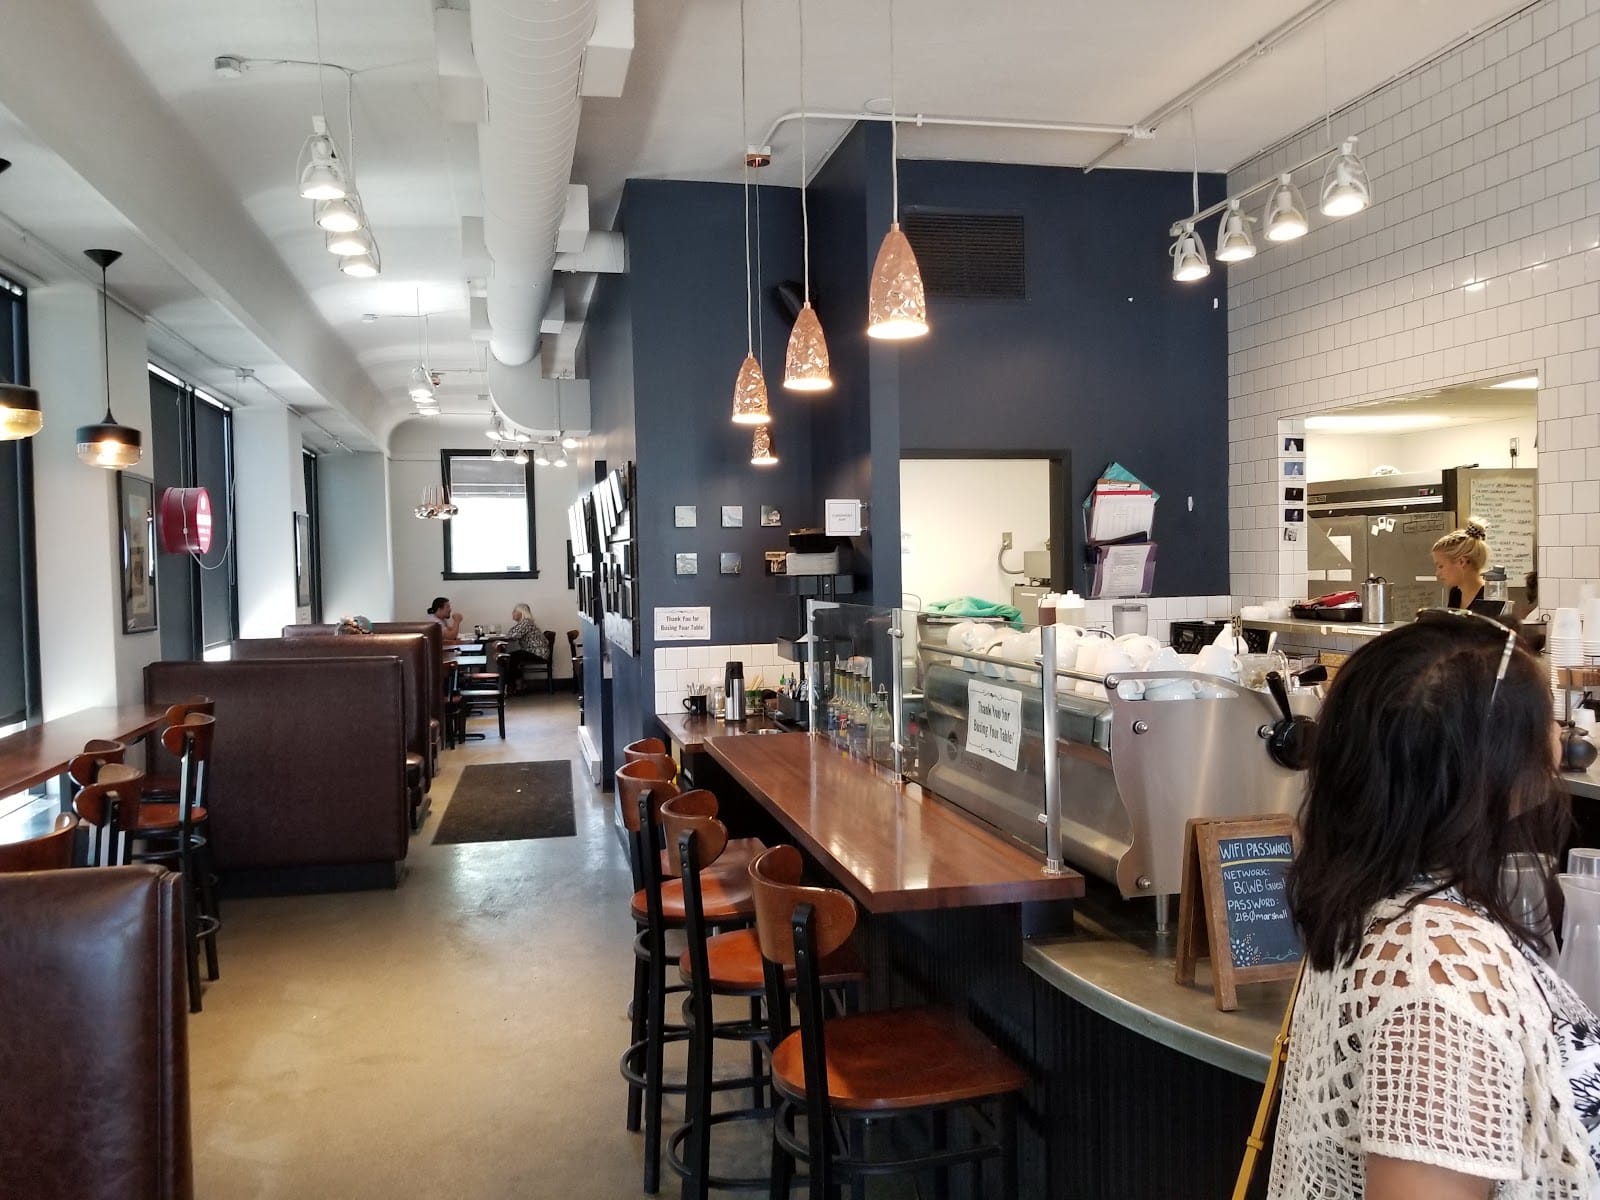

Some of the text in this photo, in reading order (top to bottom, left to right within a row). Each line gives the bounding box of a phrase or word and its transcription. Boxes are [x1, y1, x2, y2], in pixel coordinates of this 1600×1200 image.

[660, 624, 678, 632] Busing
[977, 701, 1011, 722] Thank You for
[973, 718, 1015, 744] Busing Your Table!
[1219, 841, 1292, 859] WIFI PASSWORD
[1223, 868, 1271, 880] NETWORK:
[1233, 878, 1264, 895] BCWB
[1227, 897, 1280, 911] PASSWORD:
